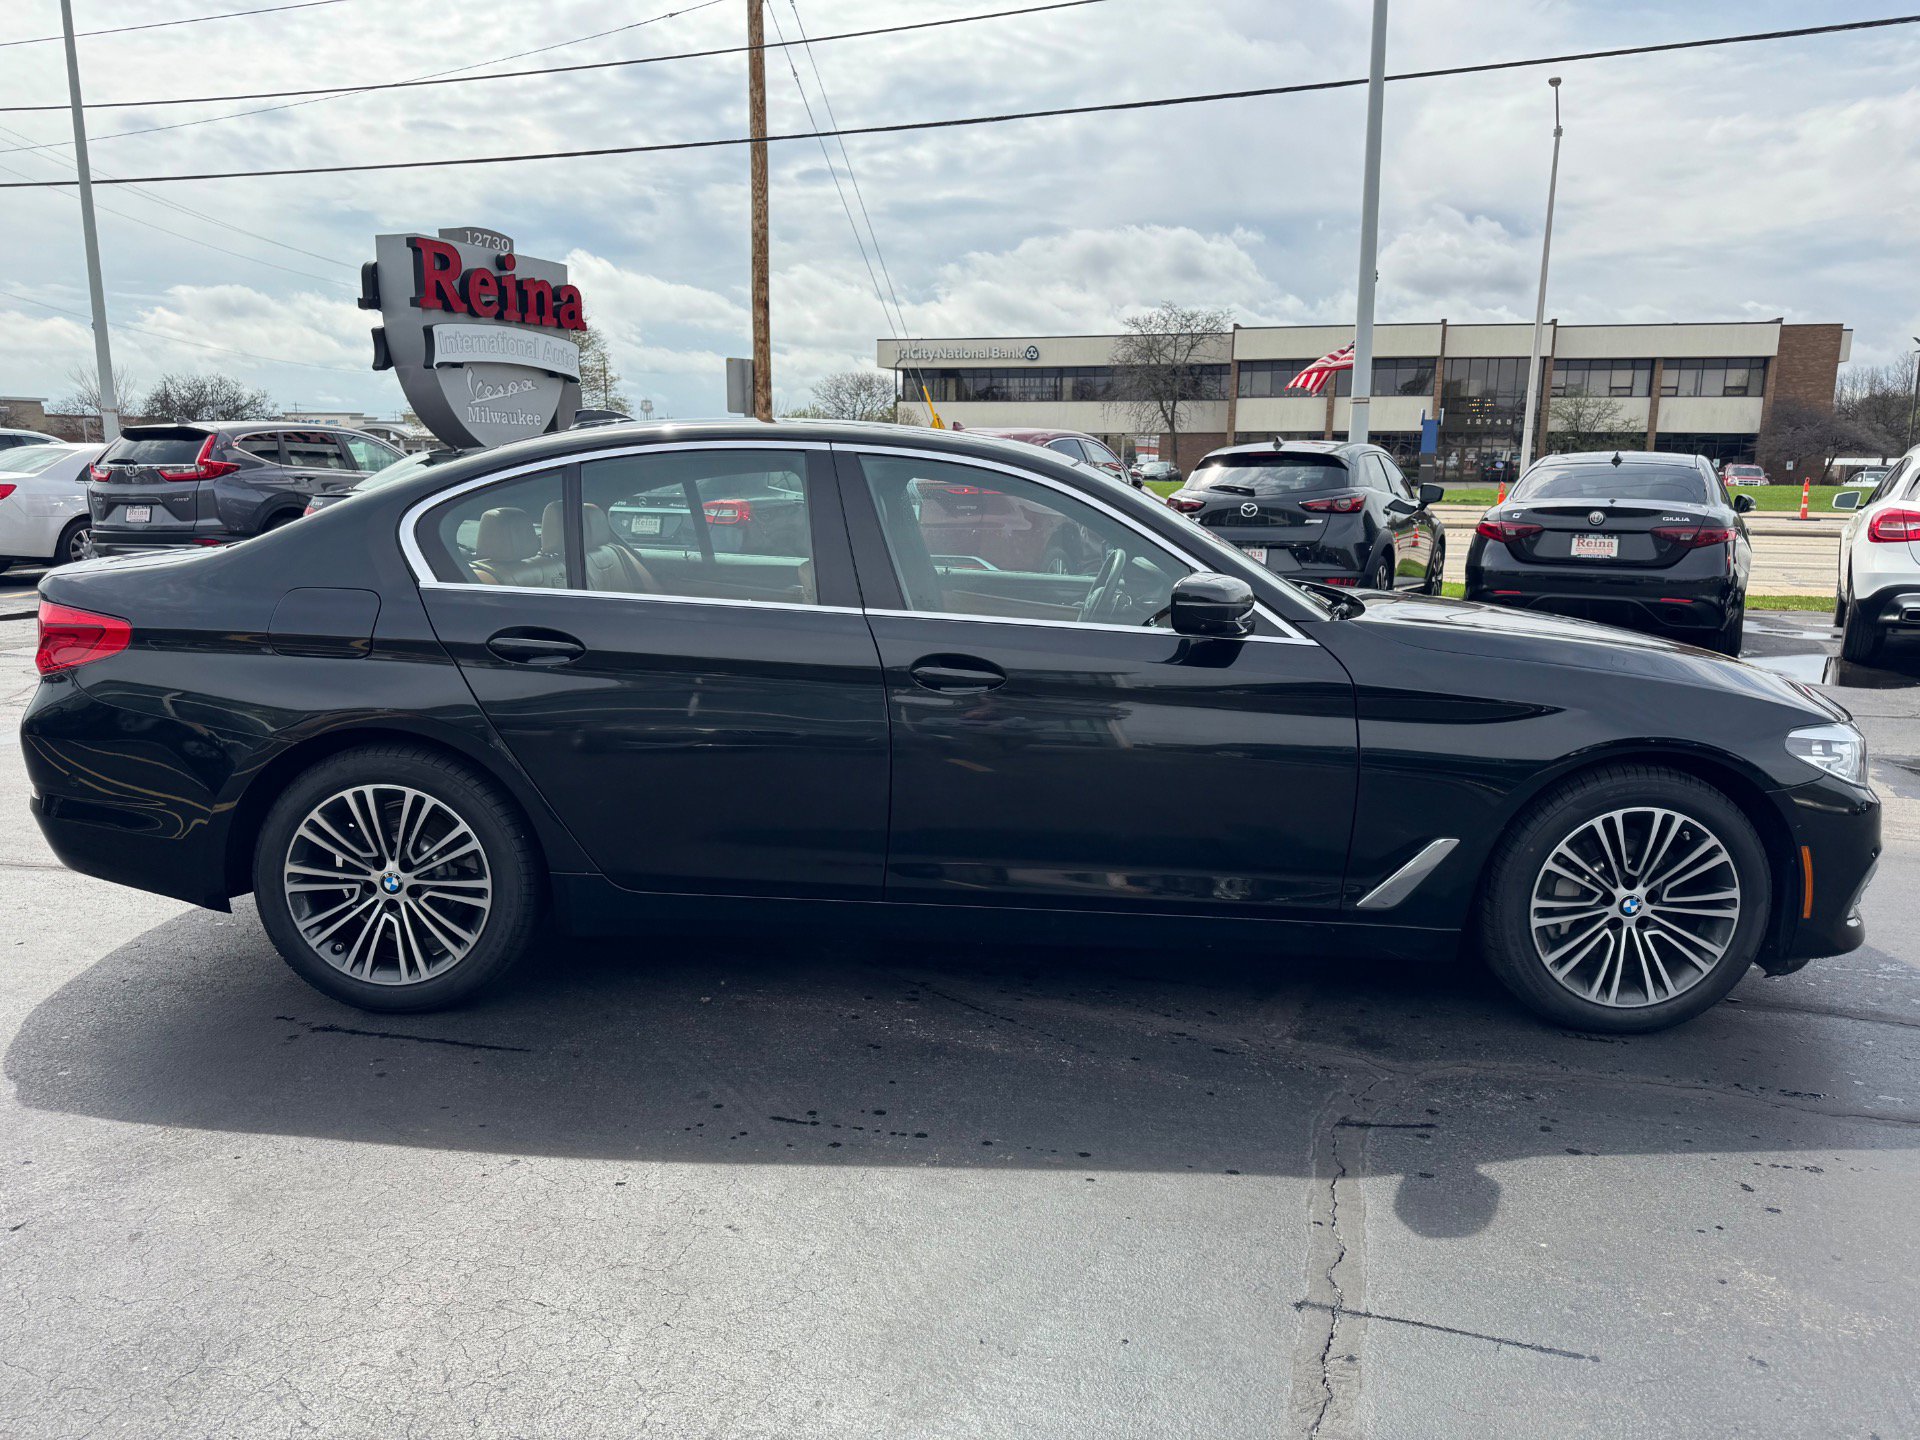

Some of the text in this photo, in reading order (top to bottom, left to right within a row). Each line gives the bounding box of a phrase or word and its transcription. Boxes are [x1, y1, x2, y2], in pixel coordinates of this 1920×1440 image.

[466, 230, 510, 252] 12730
[414, 236, 588, 332] Reina
[438, 331, 577, 370] International Auto
[937, 346, 988, 360] National
[992, 346, 1024, 360] Bank
[466, 366, 537, 404] Vespa
[467, 406, 542, 426] Milwaukee
[1576, 538, 1614, 548] Reina
